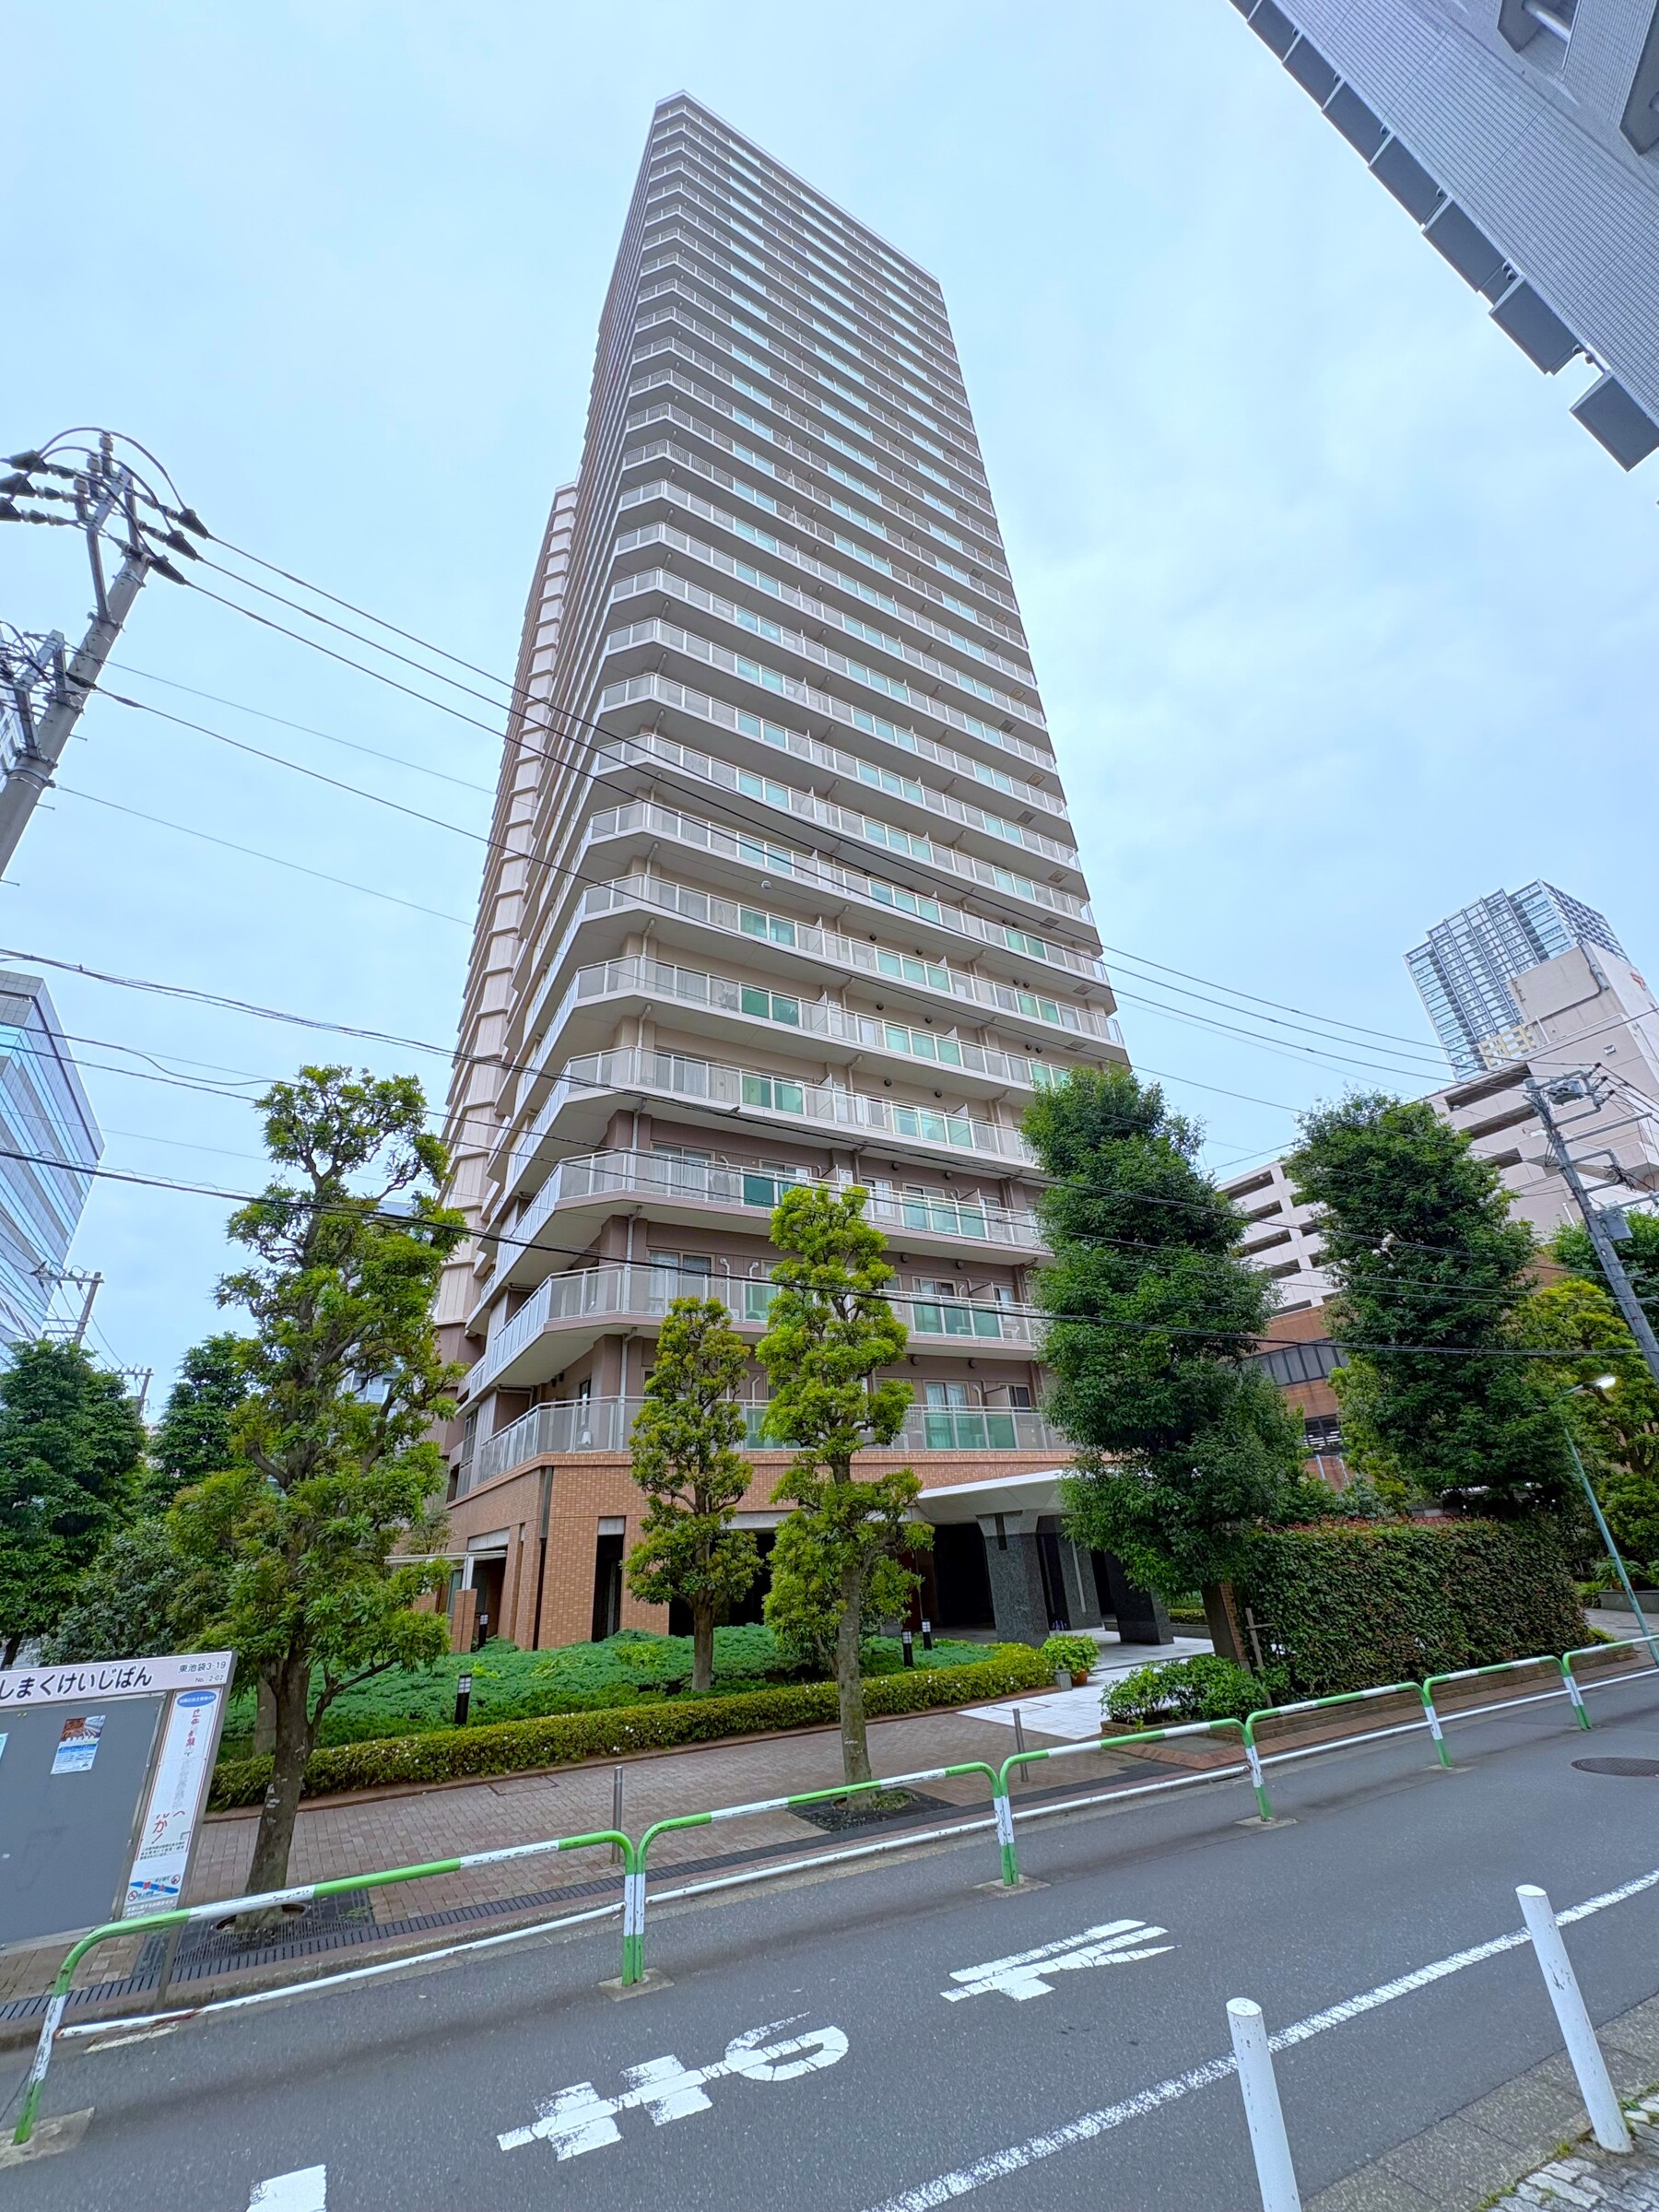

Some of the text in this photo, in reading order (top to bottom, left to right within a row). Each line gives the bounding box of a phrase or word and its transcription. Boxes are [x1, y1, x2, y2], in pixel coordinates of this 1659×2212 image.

[179, 1661, 227, 1673] 東池袋3-19
[0, 1666, 152, 1700] しまくけいじばん
